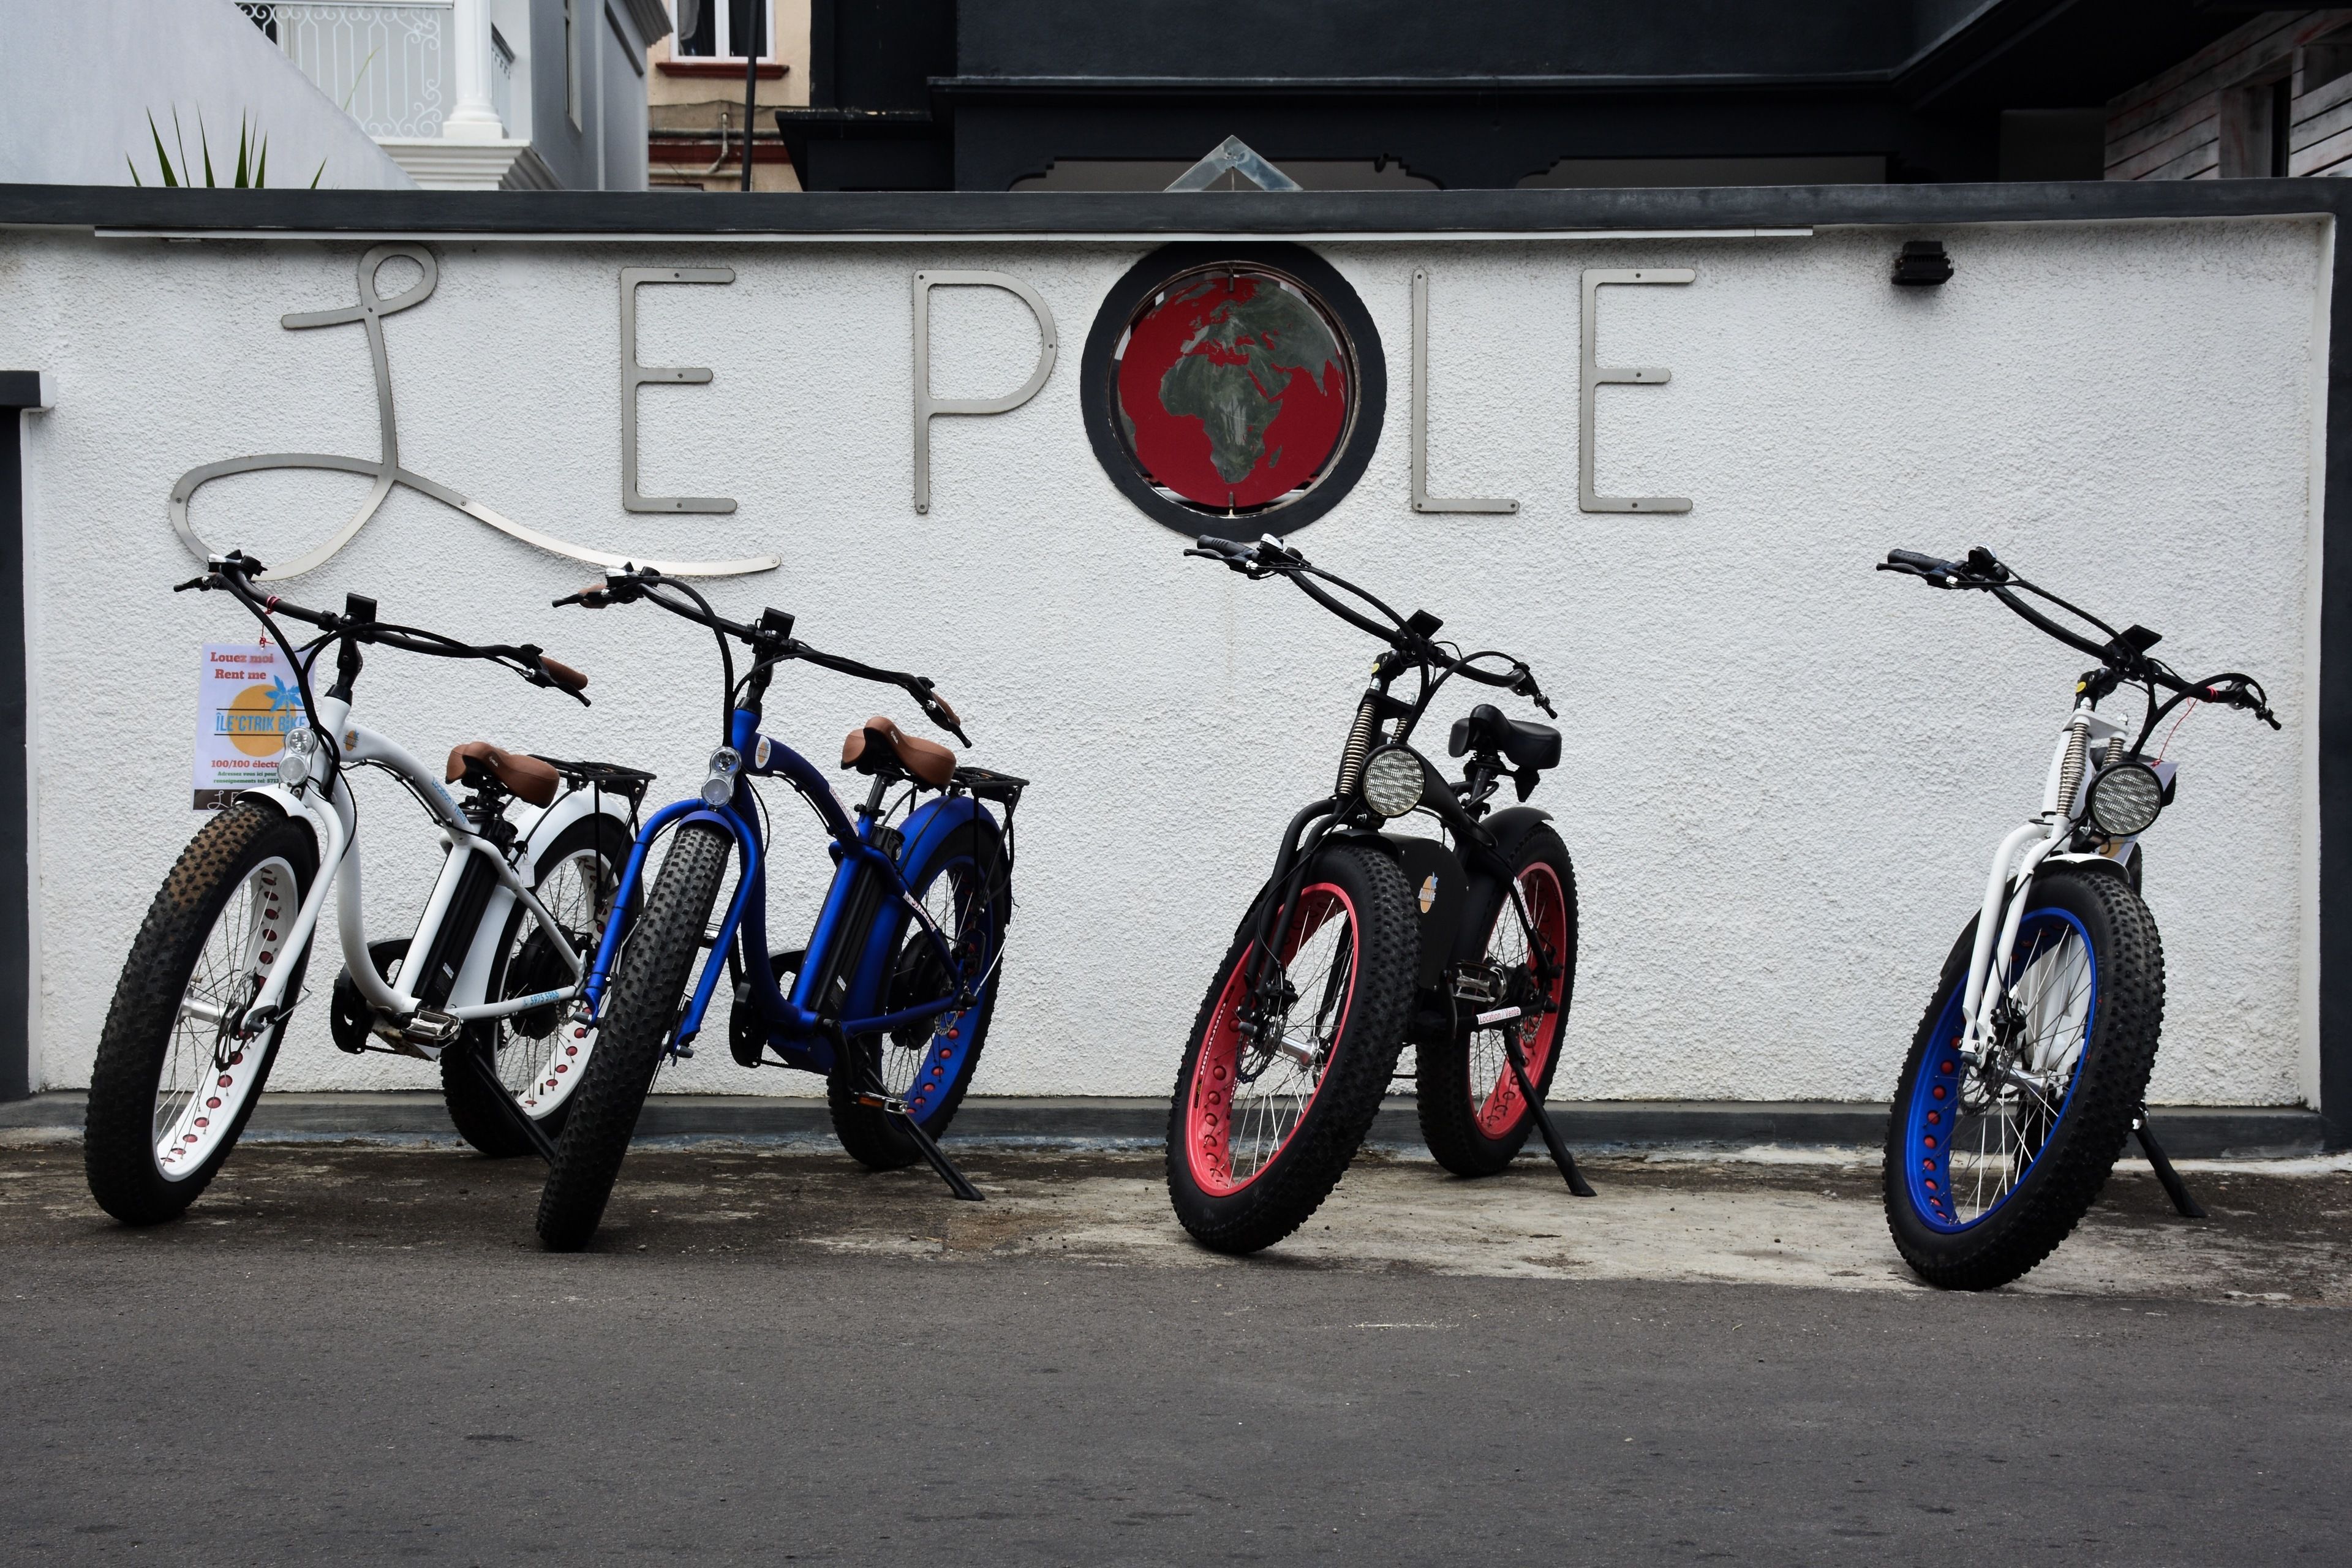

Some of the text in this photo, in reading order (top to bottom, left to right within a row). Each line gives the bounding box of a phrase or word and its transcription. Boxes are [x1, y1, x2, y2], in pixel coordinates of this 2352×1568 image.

[211, 652, 274, 663] Louez moi
[215, 669, 244, 679] Rent
[211, 760, 250, 769] 100/100
[1480, 1012, 1501, 1023] Location
[1504, 1009, 1520, 1017] Vente
